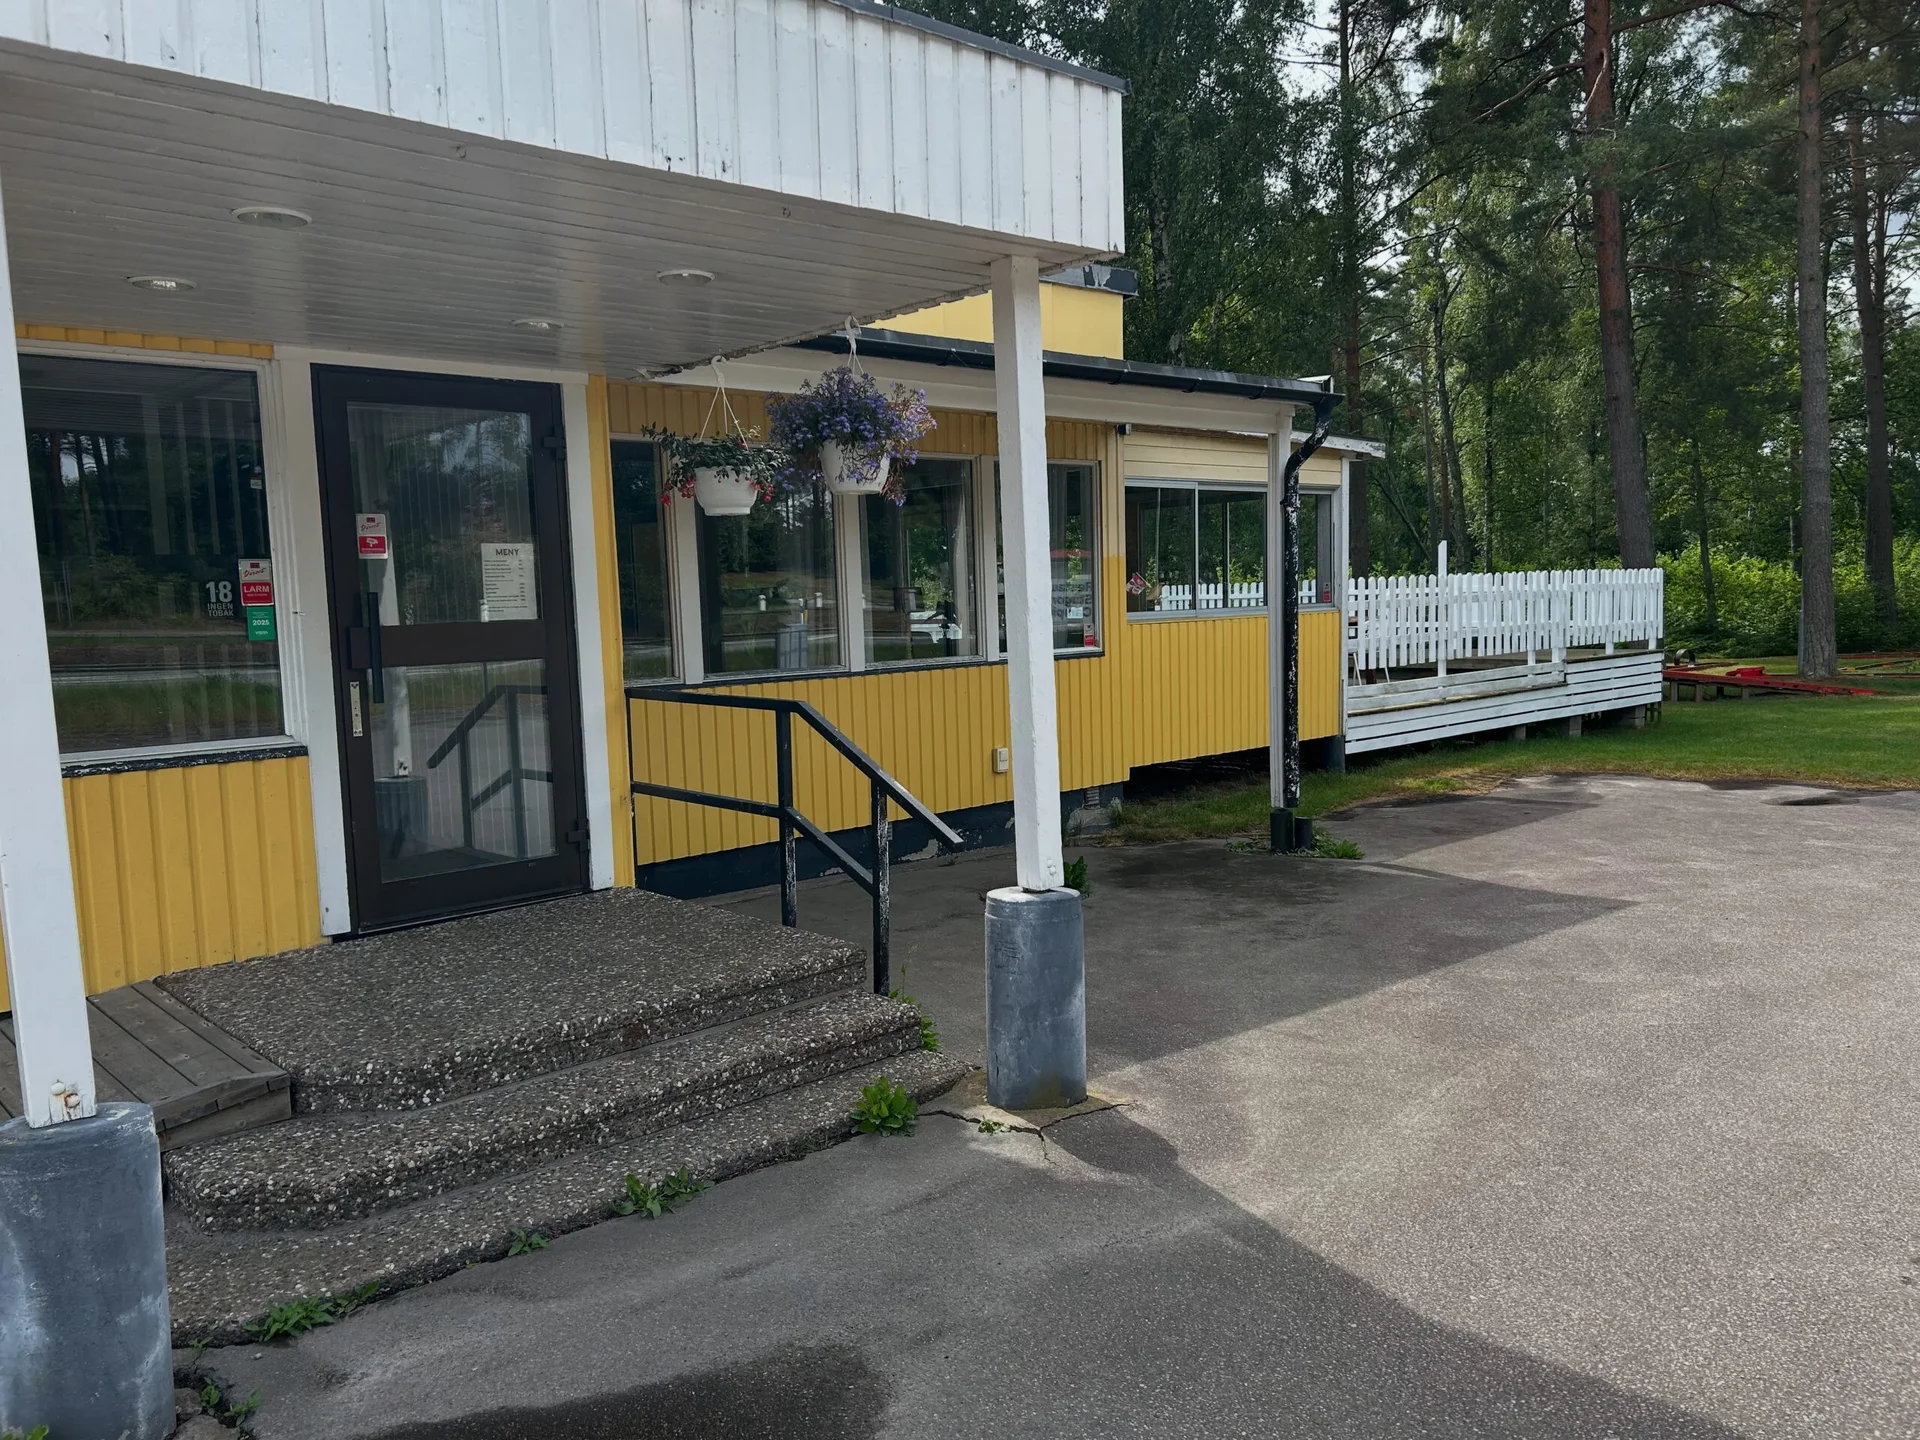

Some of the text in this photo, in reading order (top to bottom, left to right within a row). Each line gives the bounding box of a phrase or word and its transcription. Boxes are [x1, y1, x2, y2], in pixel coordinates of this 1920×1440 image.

[495, 548, 519, 556] MENY
[205, 580, 233, 602] 18
[243, 585, 270, 593] LARM
